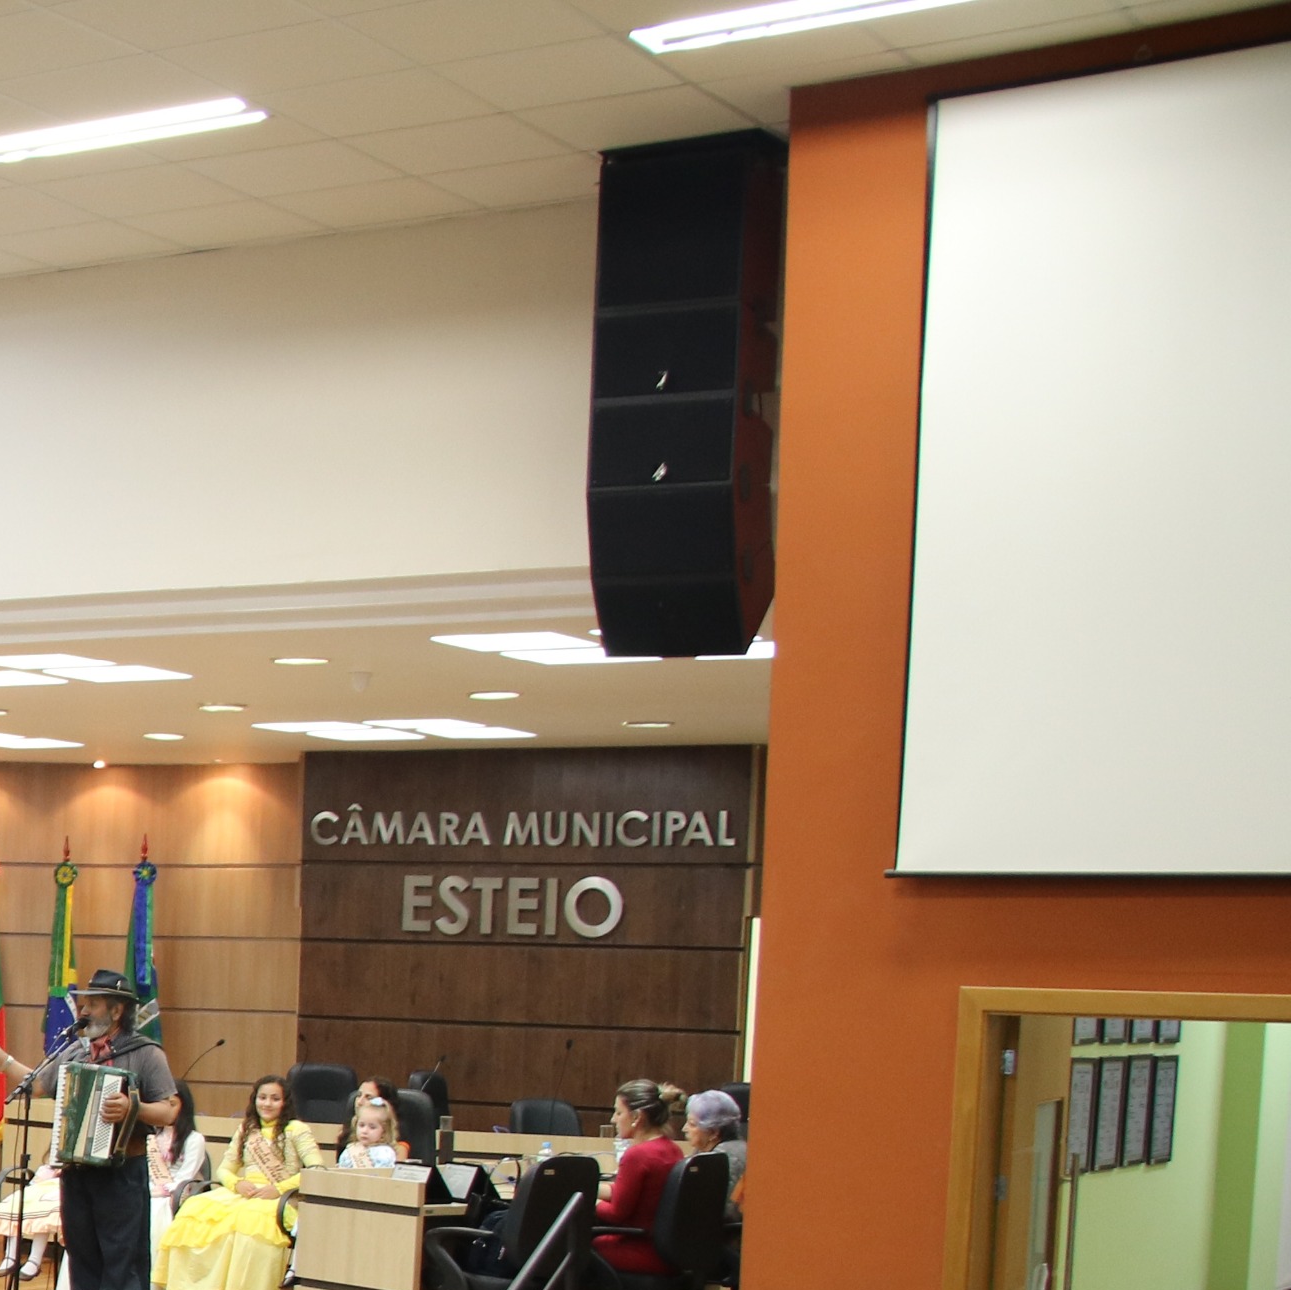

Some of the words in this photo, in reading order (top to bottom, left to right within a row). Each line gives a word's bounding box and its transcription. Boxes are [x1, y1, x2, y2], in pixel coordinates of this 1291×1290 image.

[311, 803, 491, 847] CÂMARA
[503, 810, 737, 847] MUNICIPAL
[401, 874, 624, 938] ESTEIO
